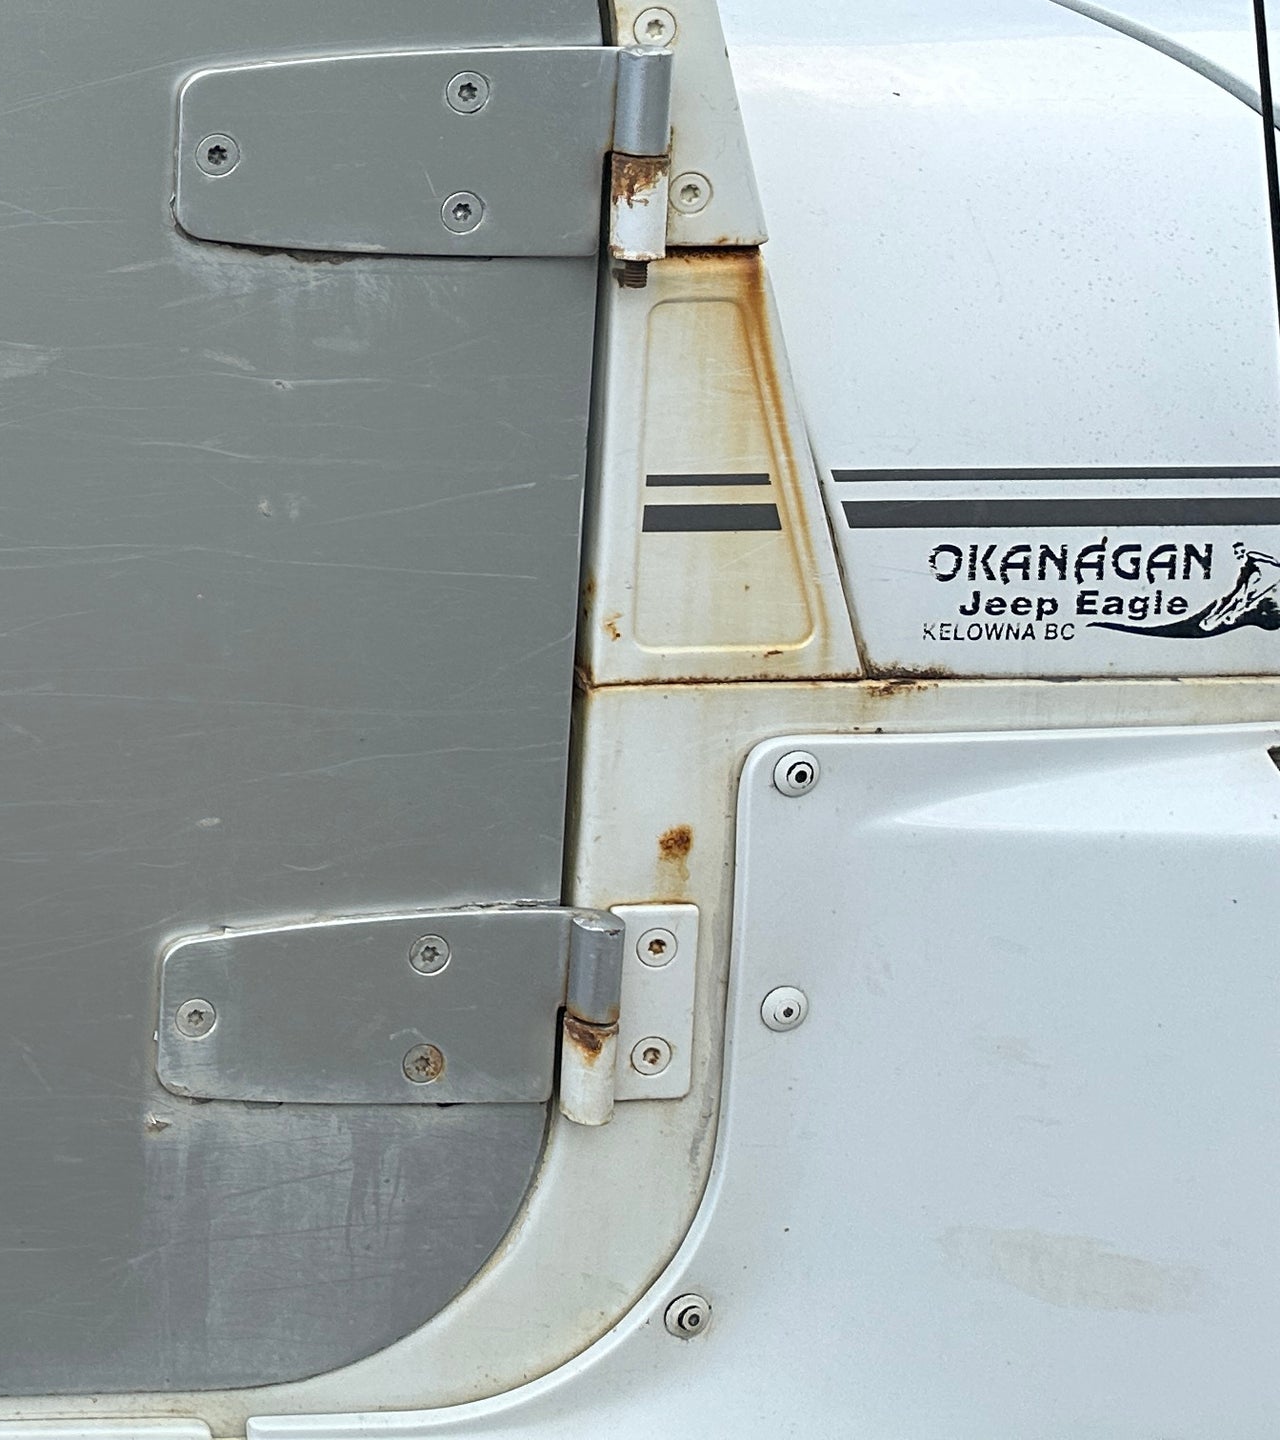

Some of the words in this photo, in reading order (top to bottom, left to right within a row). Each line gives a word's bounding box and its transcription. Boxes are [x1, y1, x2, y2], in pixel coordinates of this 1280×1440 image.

[928, 542, 1213, 584] OKANAGAN
[959, 590, 1059, 621] Jeep
[1076, 590, 1189, 620] Eagle
[923, 622, 1037, 641] KELOWNA
[1044, 622, 1076, 641] BC
